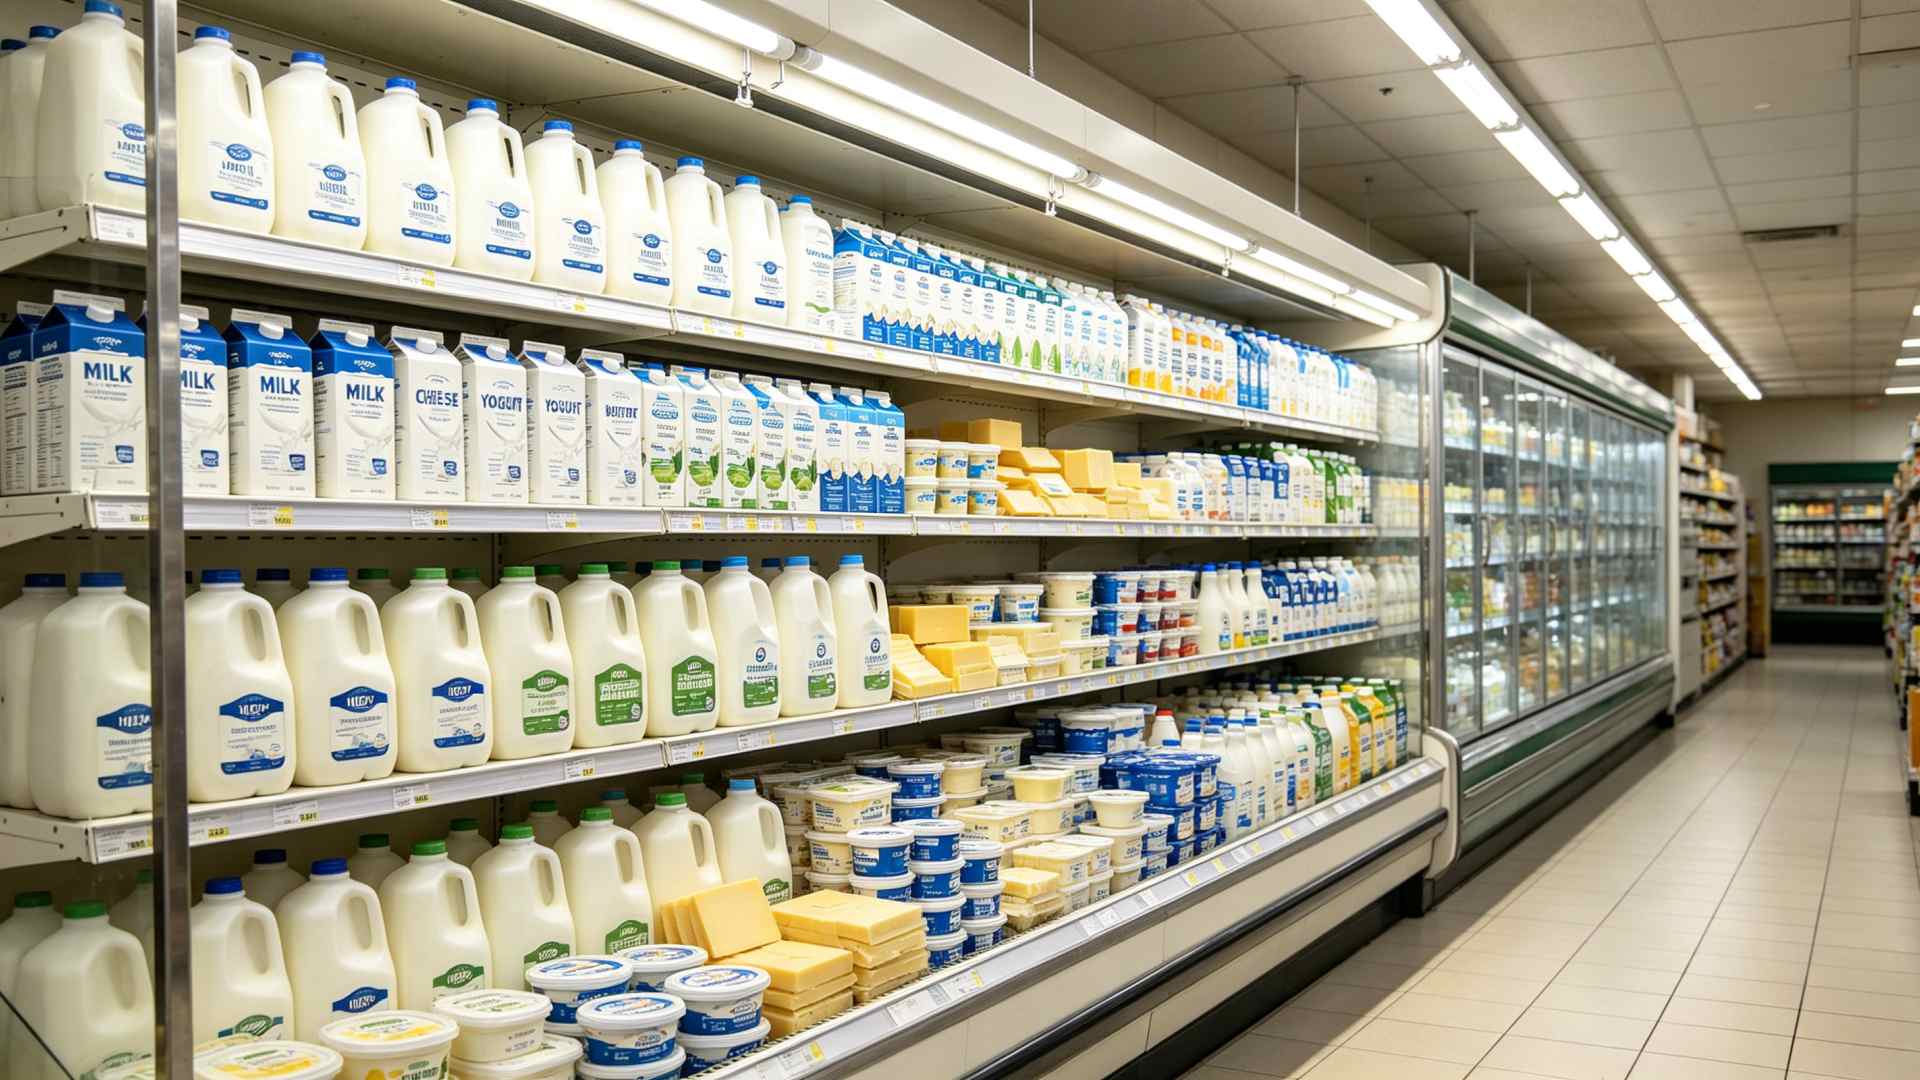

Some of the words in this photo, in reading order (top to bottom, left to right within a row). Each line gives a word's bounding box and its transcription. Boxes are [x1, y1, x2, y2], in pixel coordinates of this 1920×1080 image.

[83, 362, 134, 384] MILK
[260, 375, 301, 396] MILK
[346, 383, 385, 402] MILK
